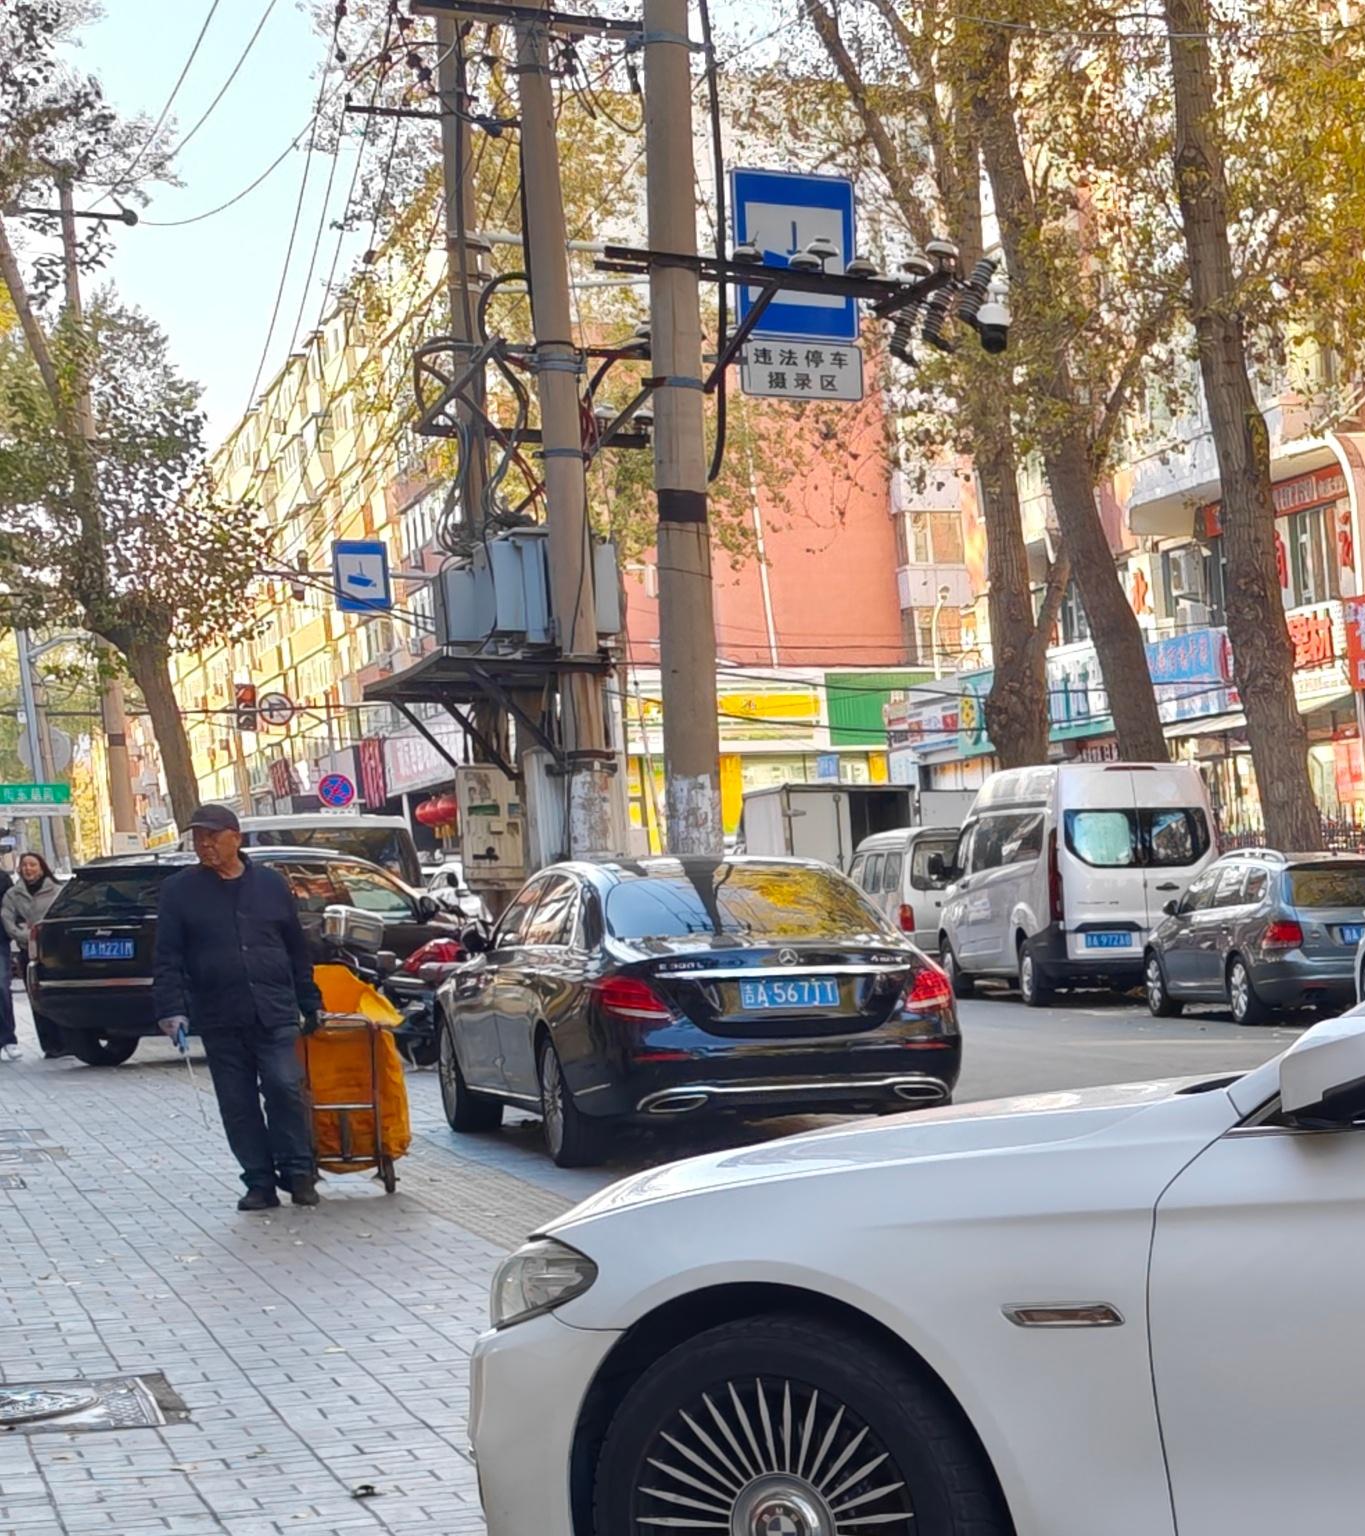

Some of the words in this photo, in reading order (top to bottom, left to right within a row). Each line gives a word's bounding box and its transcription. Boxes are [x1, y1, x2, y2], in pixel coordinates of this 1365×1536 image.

[753, 347, 848, 370] 违法停车
[768, 371, 838, 392] 摄录区
